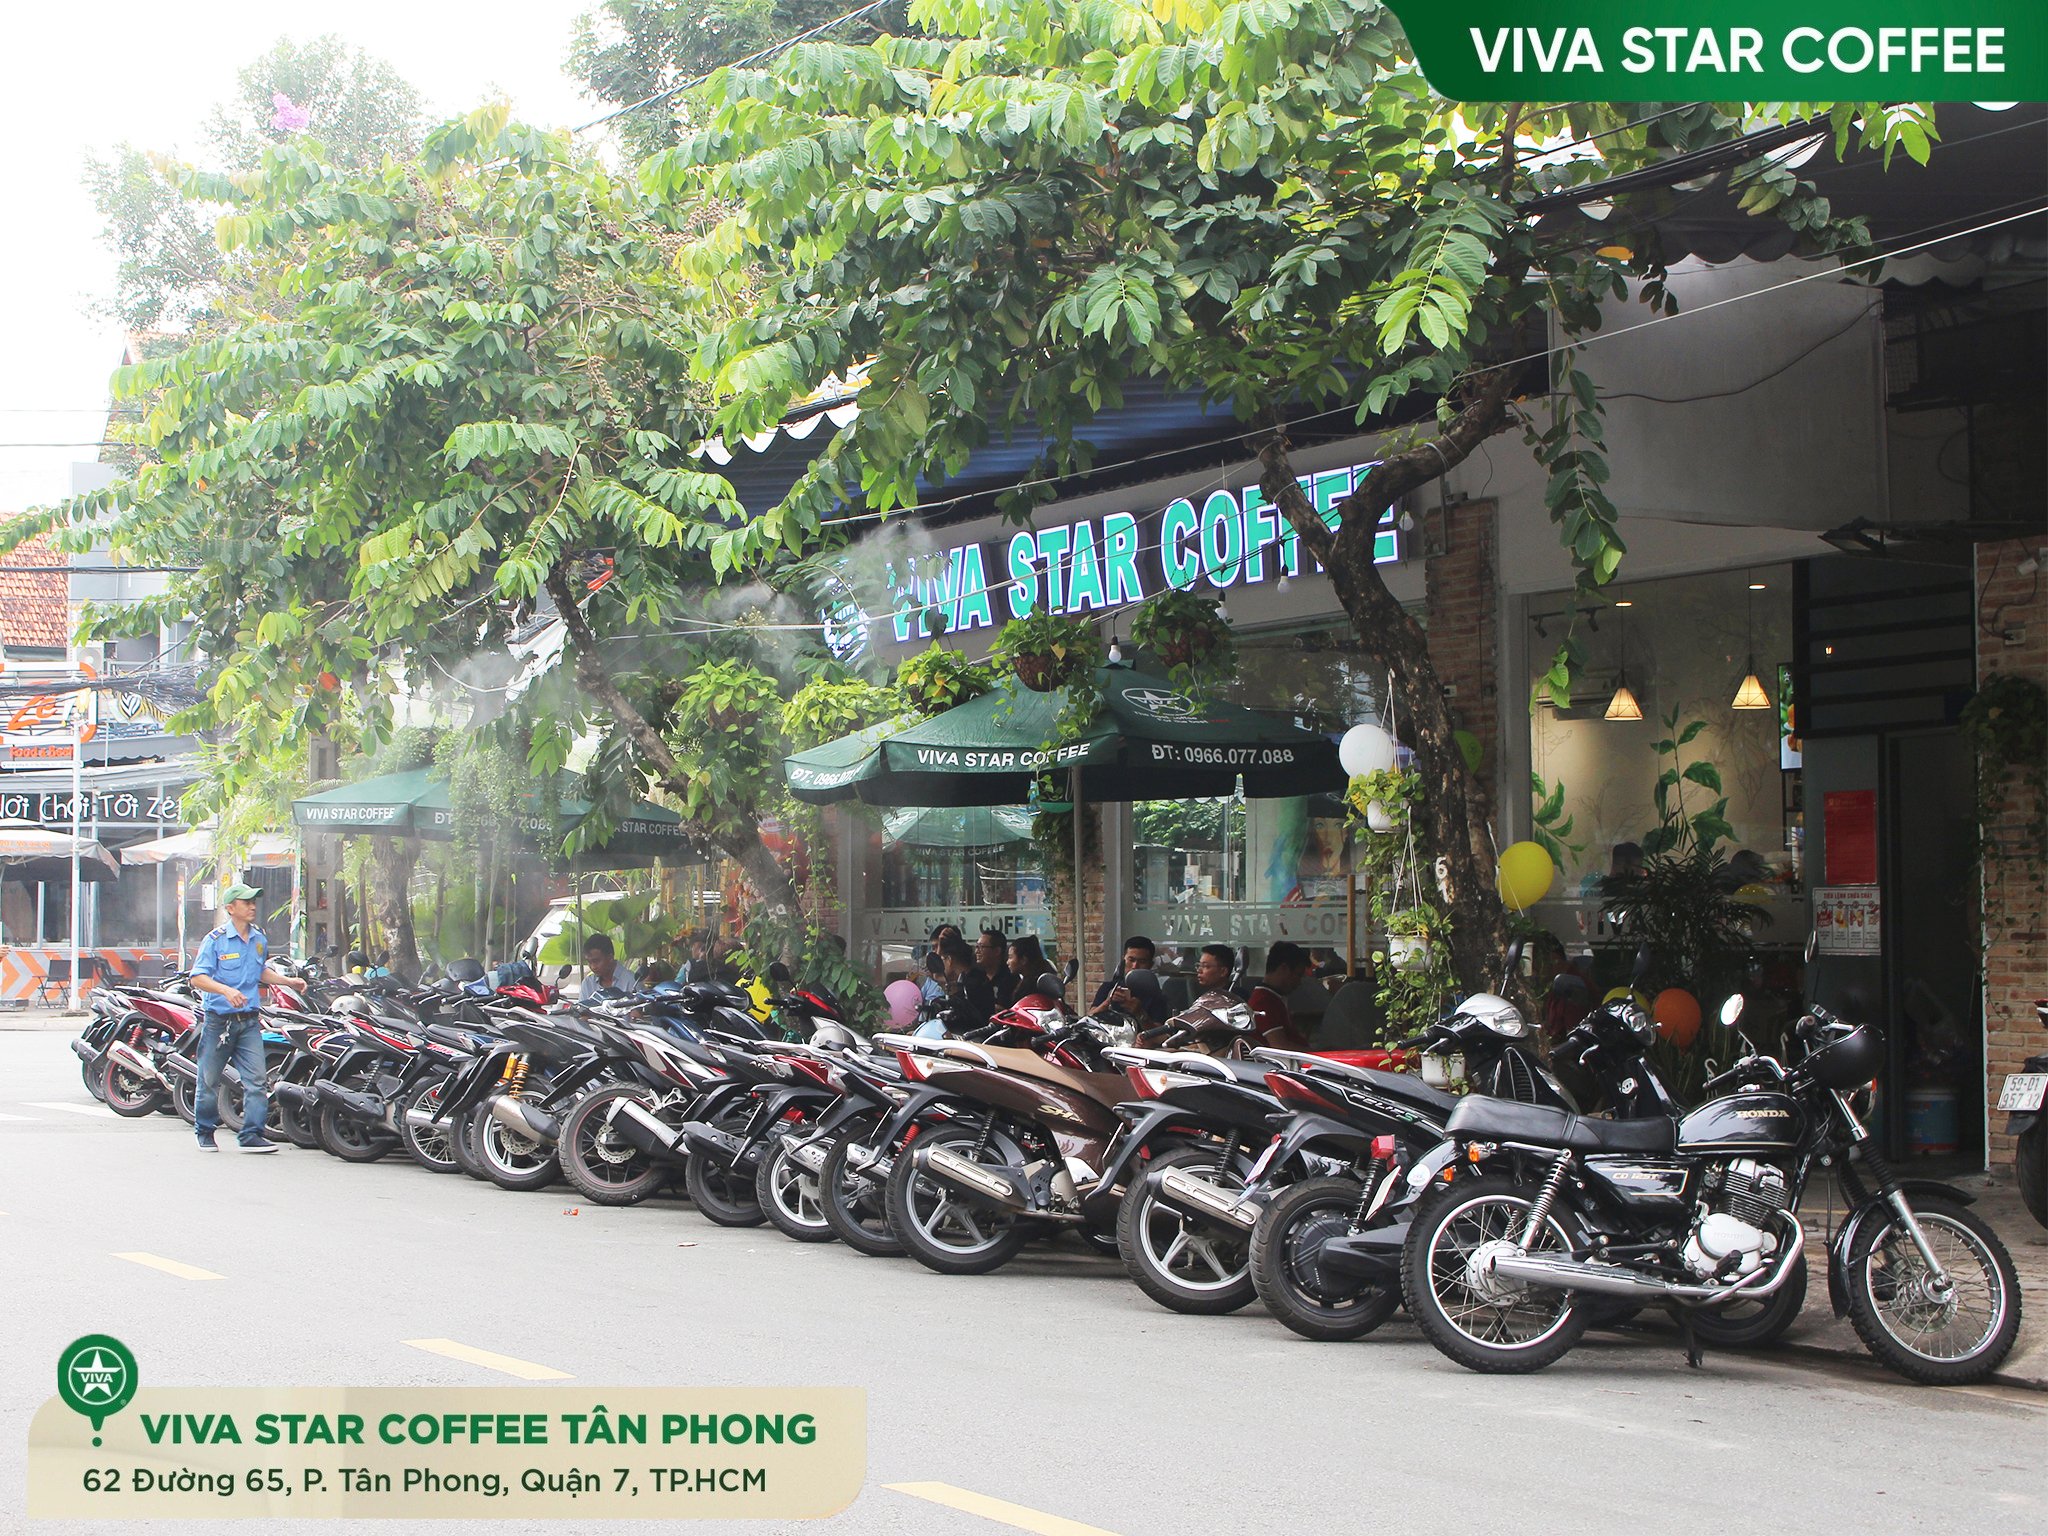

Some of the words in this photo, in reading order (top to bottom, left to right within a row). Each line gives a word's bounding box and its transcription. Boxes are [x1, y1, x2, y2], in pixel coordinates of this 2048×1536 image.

[1008, 511, 1144, 620] STAR
[1160, 459, 1399, 594] COFF
[917, 749, 959, 766] VIVA
[964, 752, 1015, 768] STAR
[1020, 743, 1091, 766] COFFEE
[1152, 744, 1181, 760] ĐT:
[1184, 747, 1295, 764] 0966.077.088
[306, 807, 329, 820] VIVA
[330, 807, 358, 820] STAR
[358, 807, 396, 820] COFFEE
[622, 821, 647, 834] STAR
[1735, 1110, 1790, 1119] HONDA
